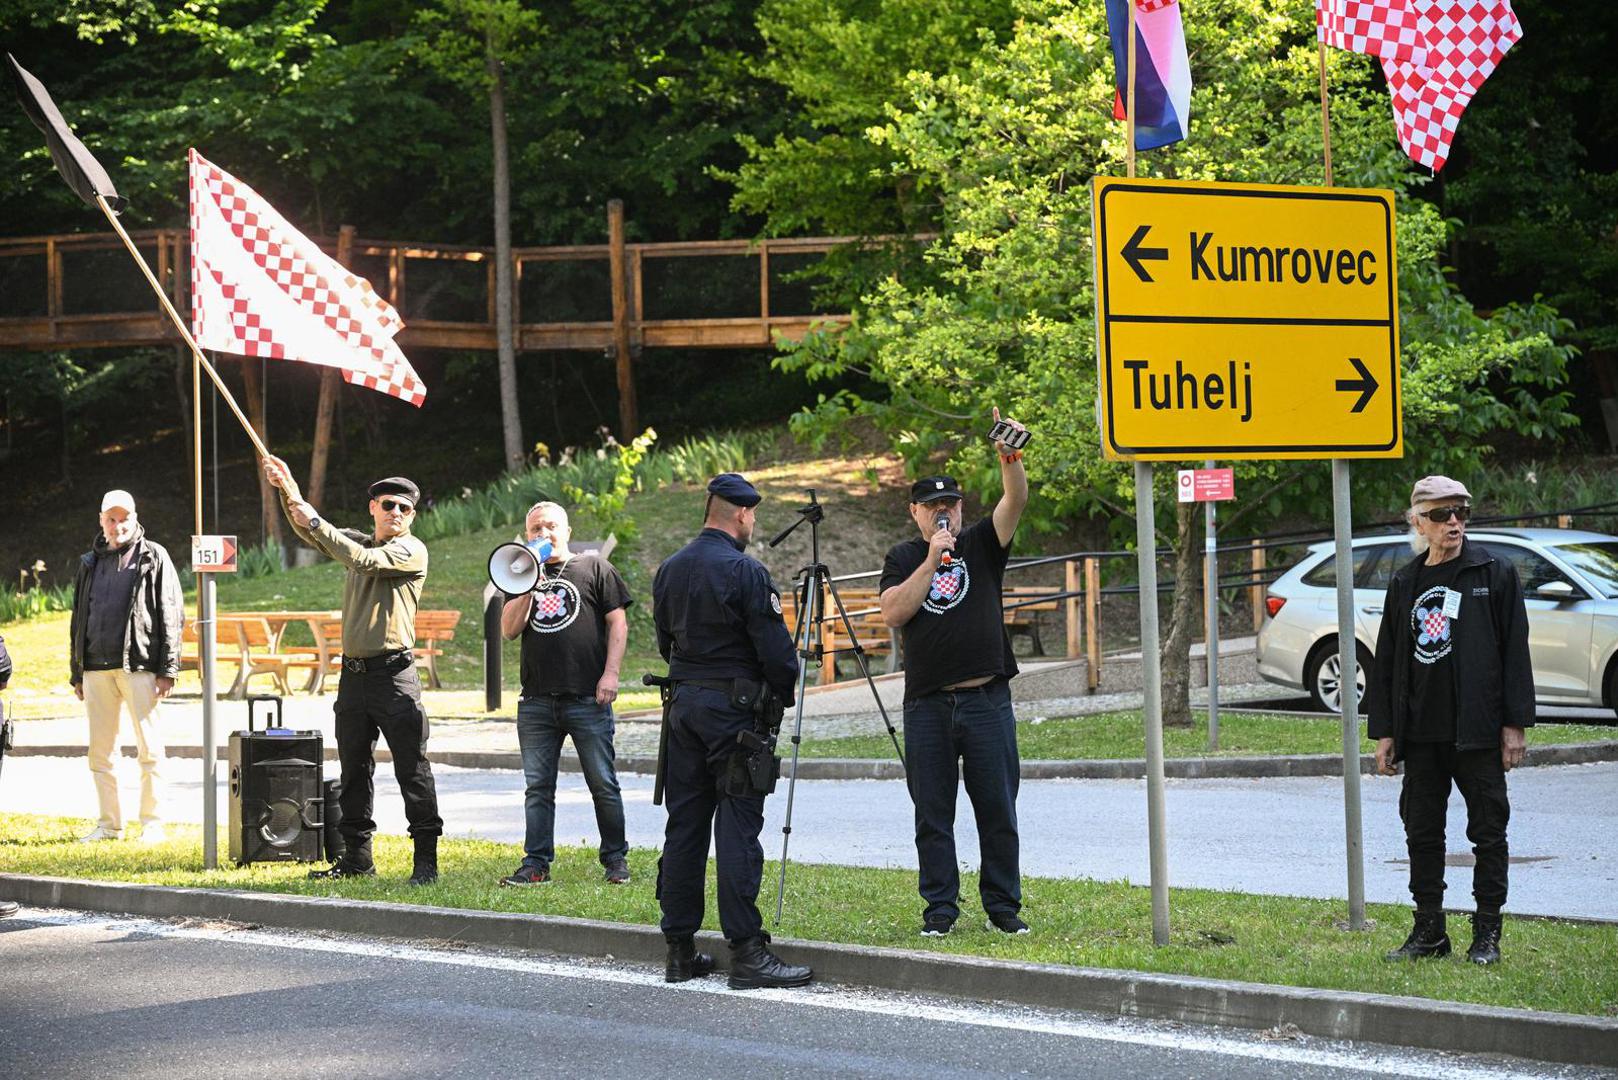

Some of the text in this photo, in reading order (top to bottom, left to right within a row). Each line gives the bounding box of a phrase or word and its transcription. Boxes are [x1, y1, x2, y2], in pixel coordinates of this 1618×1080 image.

[1190, 231, 1377, 285] Kumrovec
[1123, 360, 1253, 423] Tuhelj
[197, 550, 218, 563] 151
